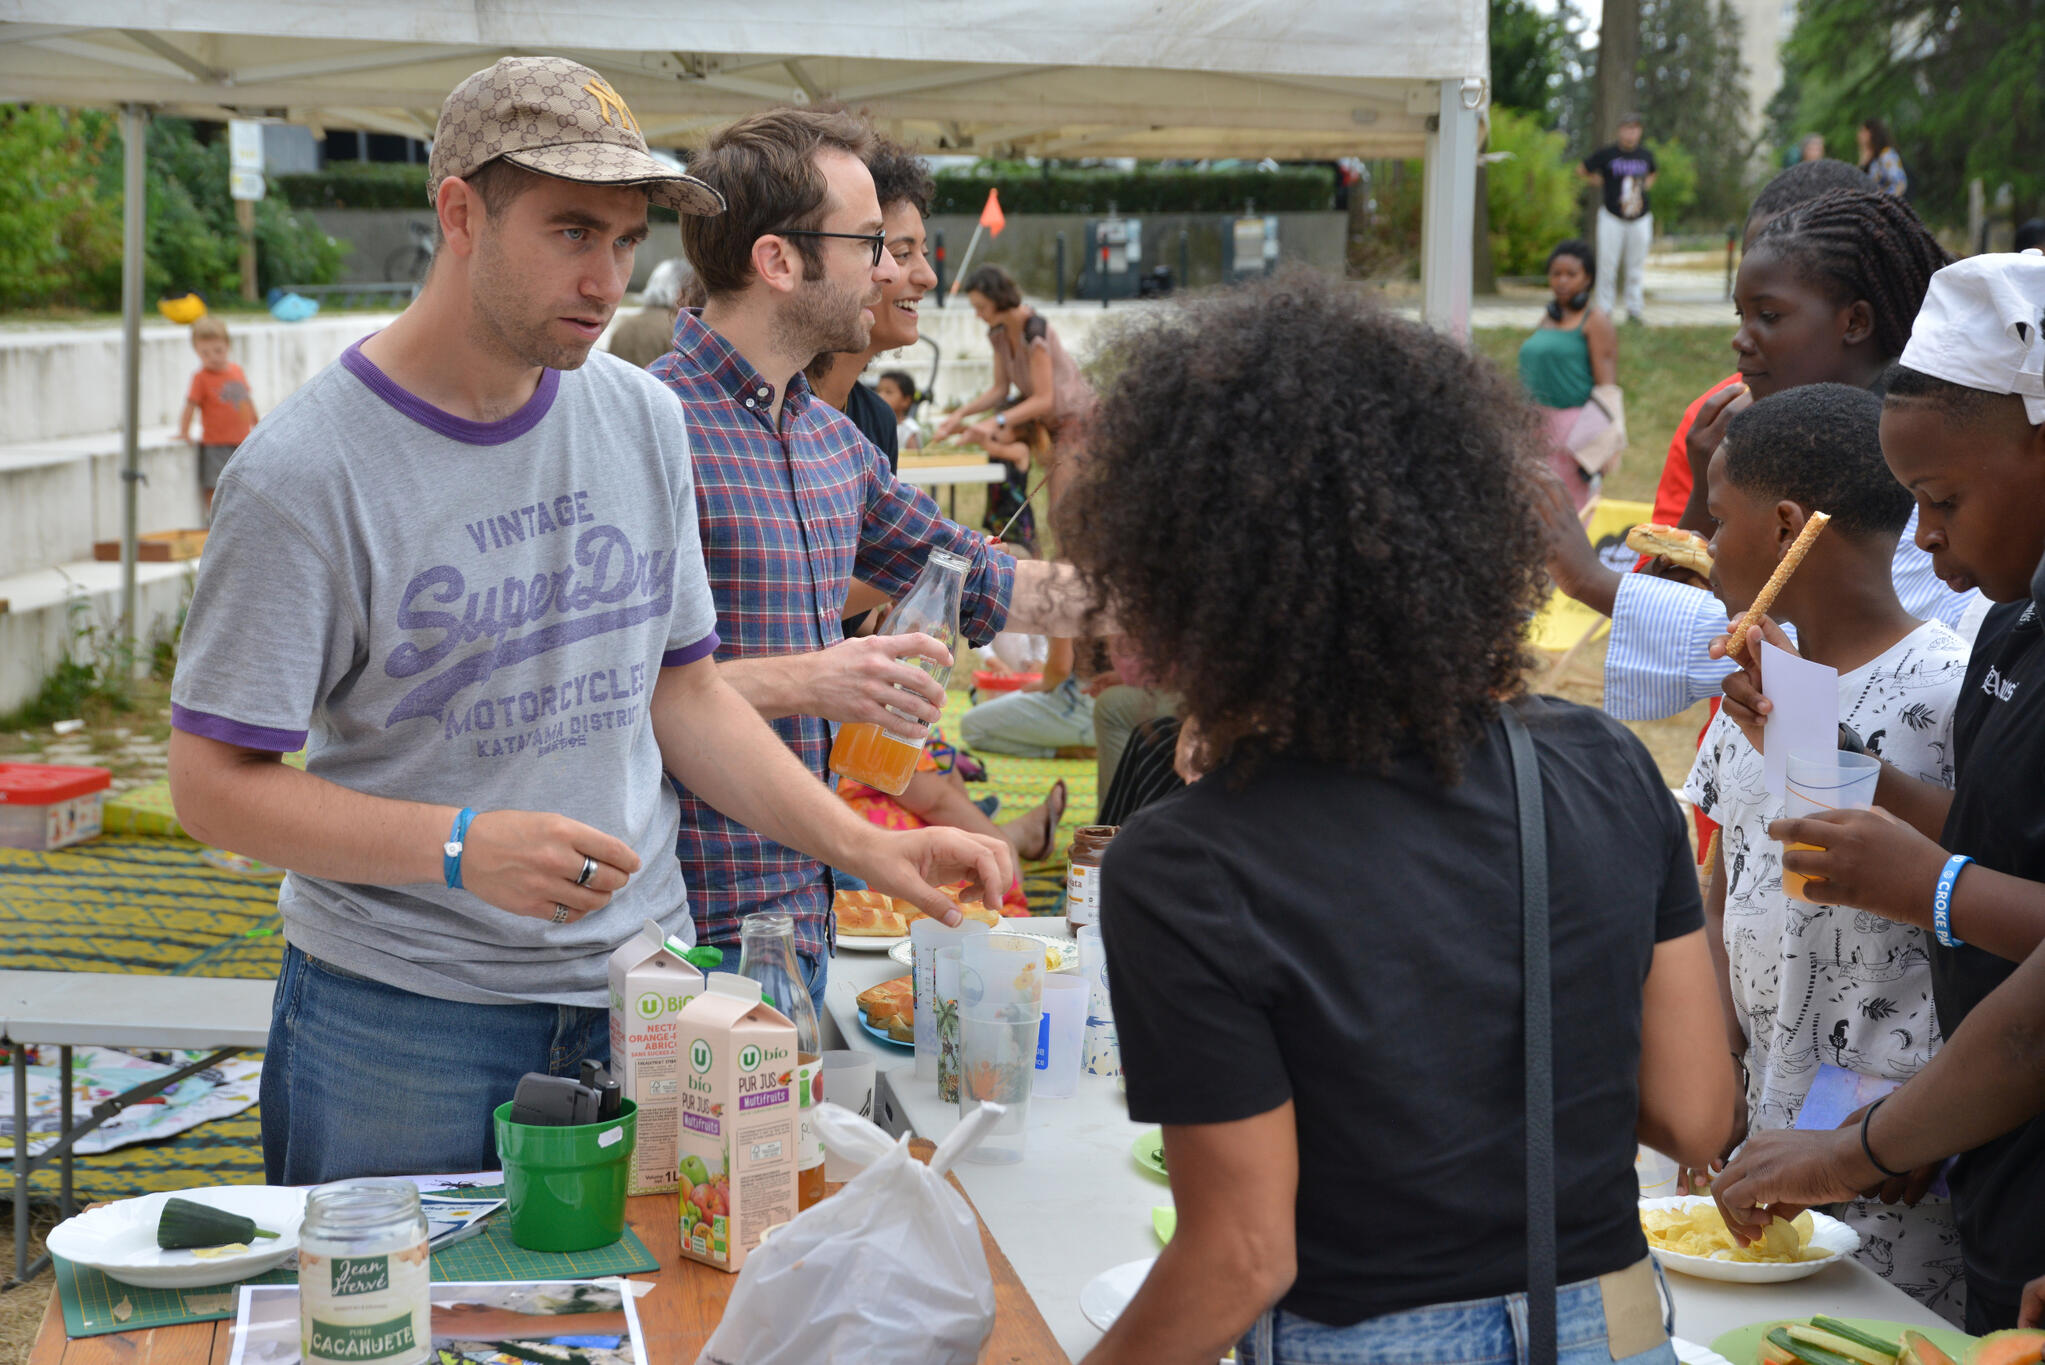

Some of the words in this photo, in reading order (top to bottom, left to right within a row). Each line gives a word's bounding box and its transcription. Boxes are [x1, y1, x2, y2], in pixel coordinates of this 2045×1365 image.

[465, 490, 595, 554] VINTAGE
[570, 703, 639, 735] DISTRI
[1935, 881, 1951, 928] CROKE
[647, 1024, 677, 1033] NECTA
[645, 1041, 677, 1050] ABRIC
[694, 1048, 707, 1066] U
[743, 1052, 756, 1066] U
[739, 1077, 757, 1093] PUR
[760, 1072, 777, 1090] JUS
[682, 1092, 695, 1111] PUR
[697, 1096, 709, 1114] JUS
[743, 1091, 785, 1108] Multifruits
[340, 1260, 384, 1282] Jean
[331, 1273, 387, 1295] Hervé
